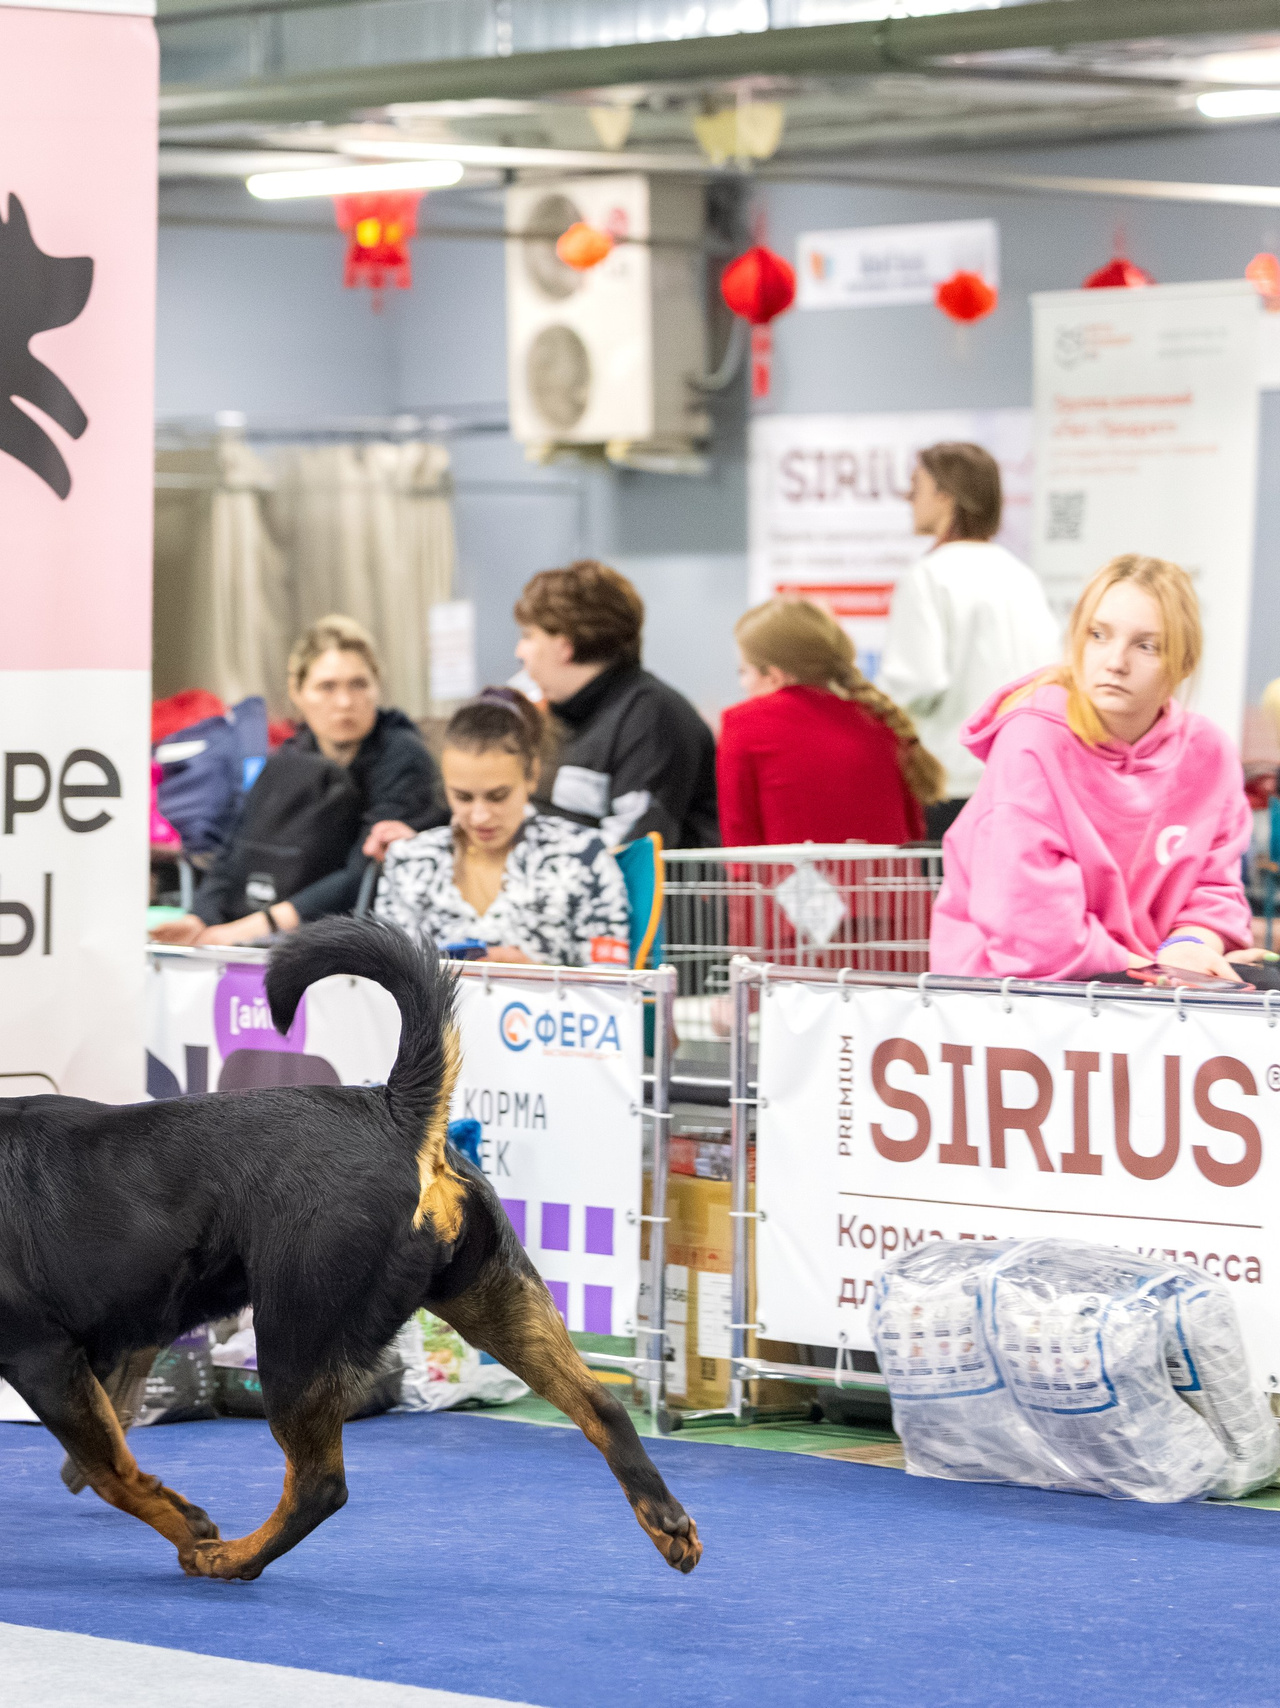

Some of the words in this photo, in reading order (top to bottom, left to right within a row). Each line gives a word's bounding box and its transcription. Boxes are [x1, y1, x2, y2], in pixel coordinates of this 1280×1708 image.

[780, 448, 915, 503] SIRIU
[499, 1001, 622, 1052] СФЕРА
[464, 1088, 547, 1130] КОРМА
[837, 1034, 855, 1157] PREMIUM
[869, 1037, 1263, 1188] SIRIUS
